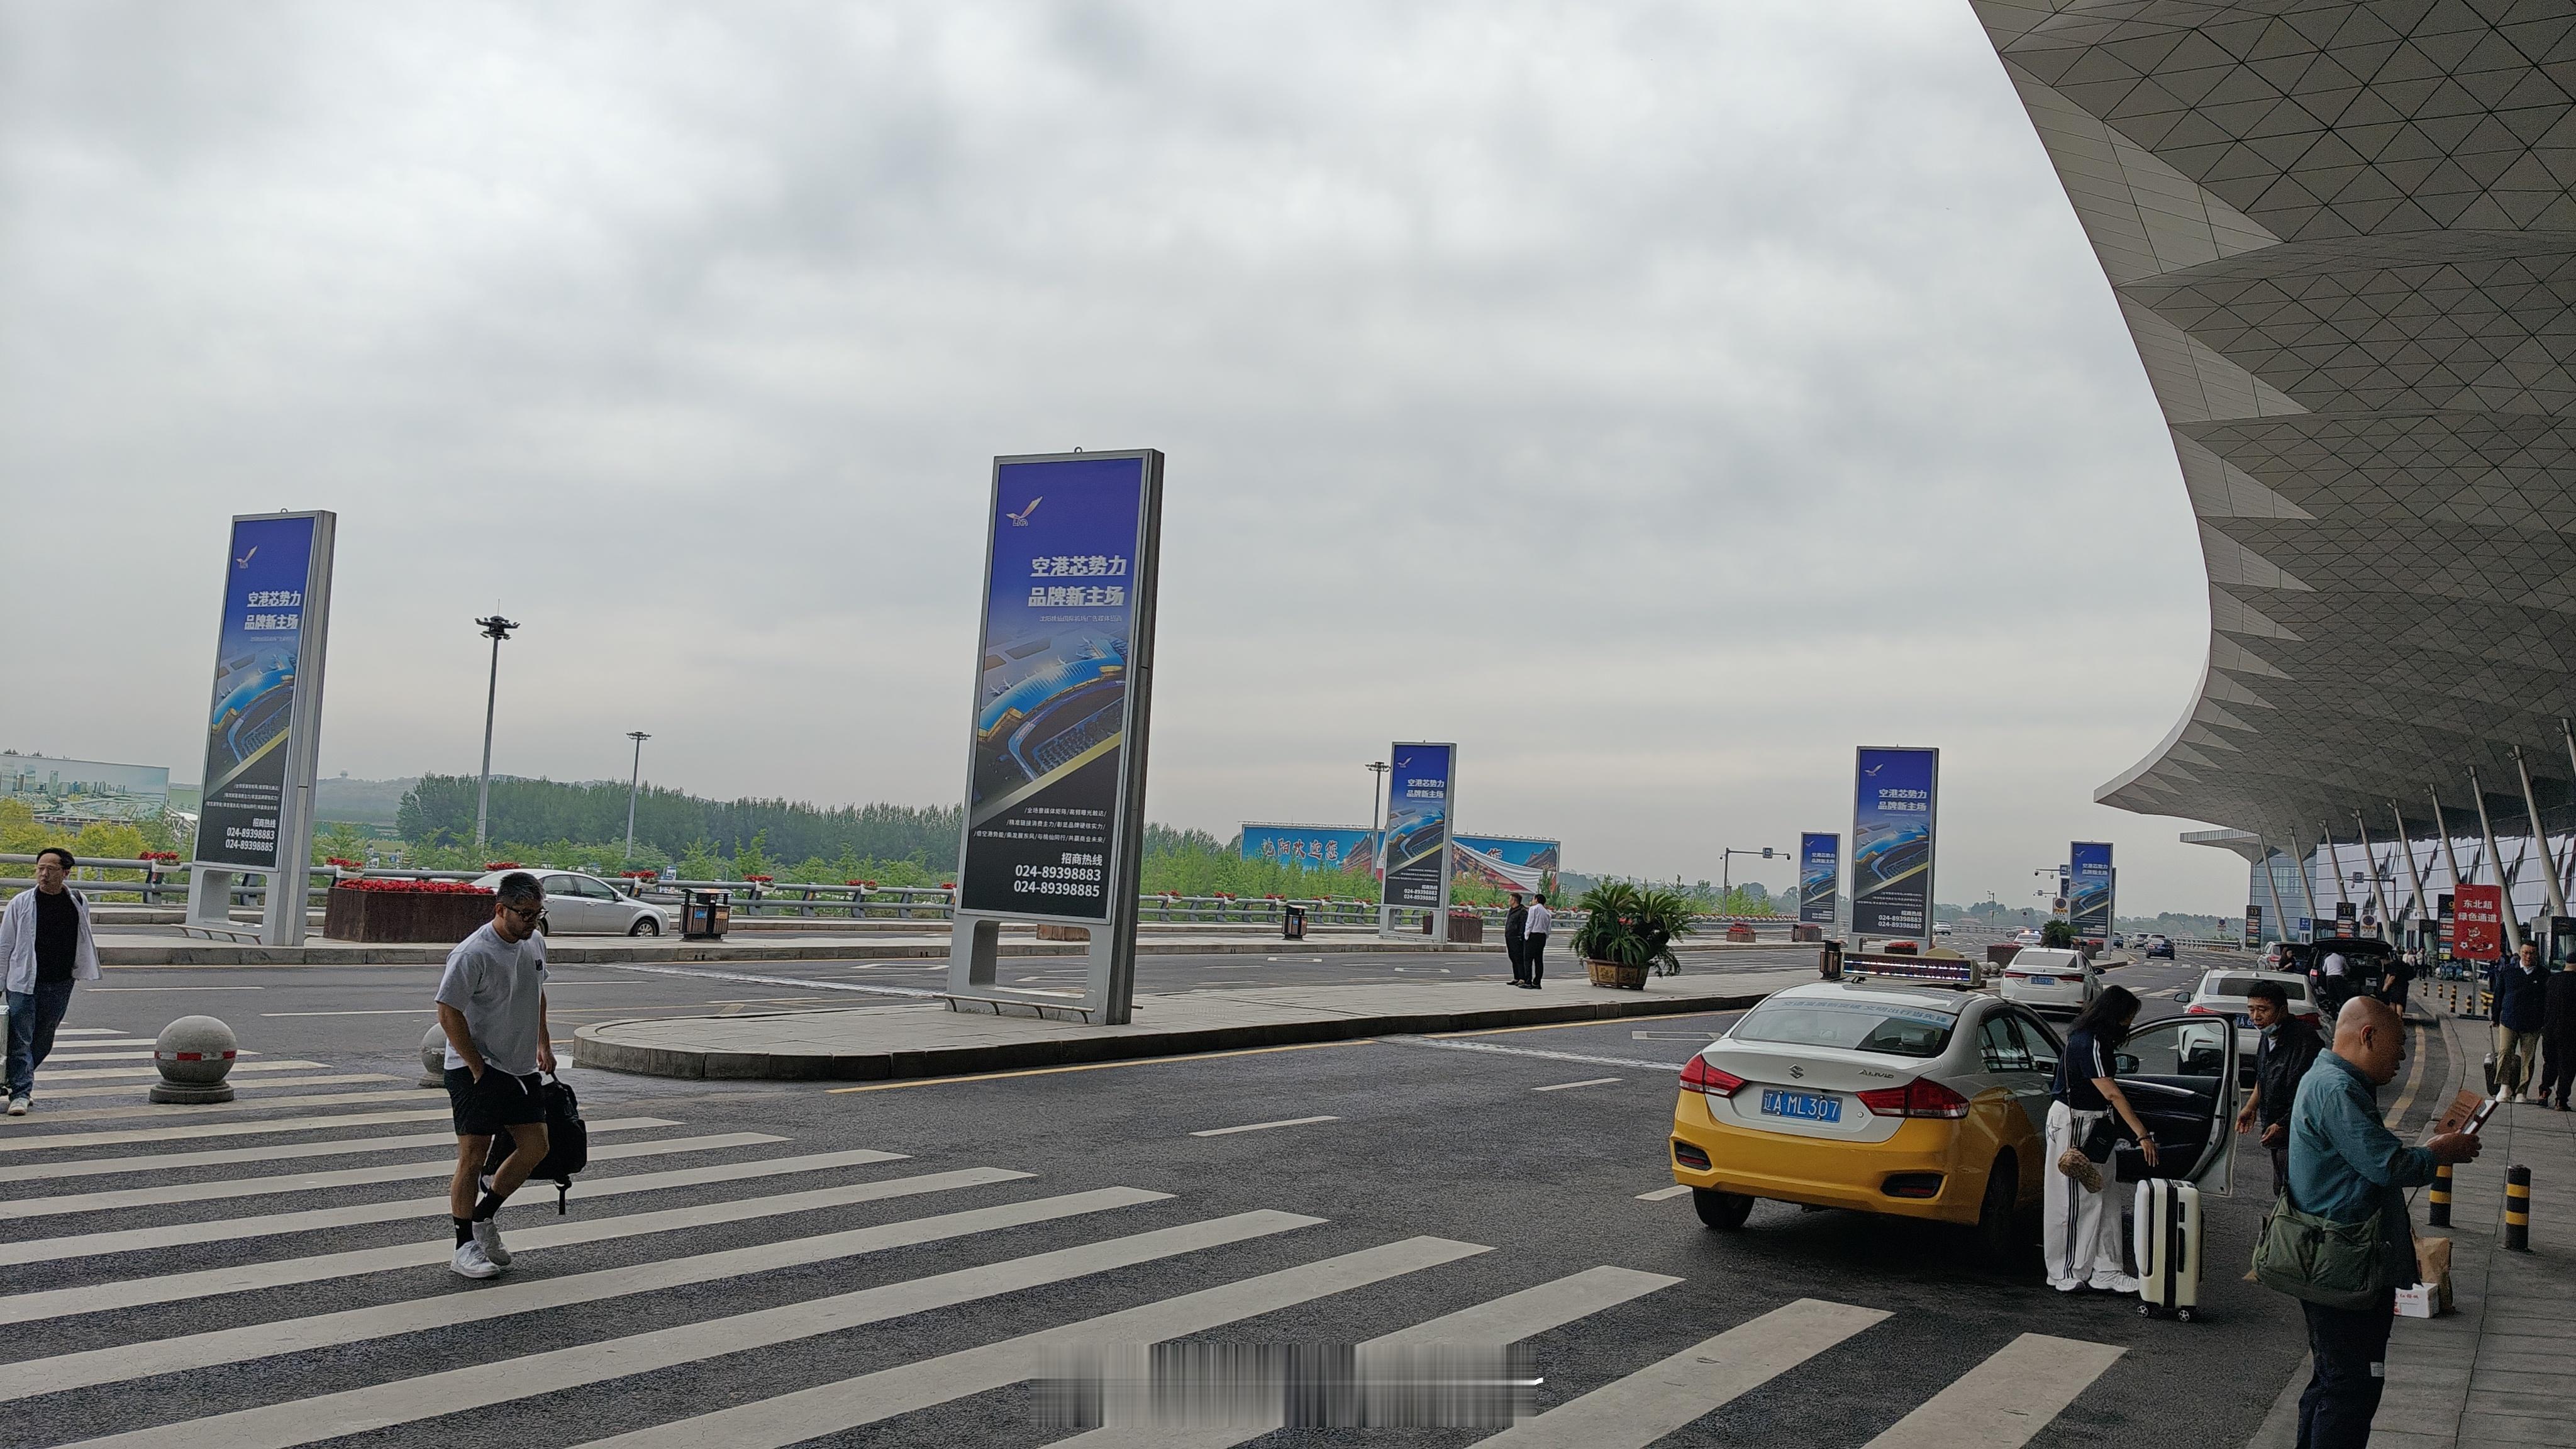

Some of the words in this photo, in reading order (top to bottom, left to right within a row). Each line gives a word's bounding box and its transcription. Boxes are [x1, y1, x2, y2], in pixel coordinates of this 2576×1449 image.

[1031, 555, 1127, 577] 空港芯势力
[247, 591, 301, 607] 空港芯势力
[1028, 586, 1125, 607] 品牌新主场
[244, 614, 299, 630] 品牌新主场
[1879, 789, 1927, 799] 空港芯势力
[1878, 801, 1927, 811] 品牌新主场
[253, 818, 276, 828] 招商热线
[227, 827, 275, 840] 024-89398883
[225, 839, 274, 852] 024-89398885
[1062, 852, 1102, 866] 招商热线
[1015, 865, 1101, 881] 024-89398883
[1014, 880, 1100, 897] 024-89398885
[2458, 912, 2497, 923] 绿色通道
